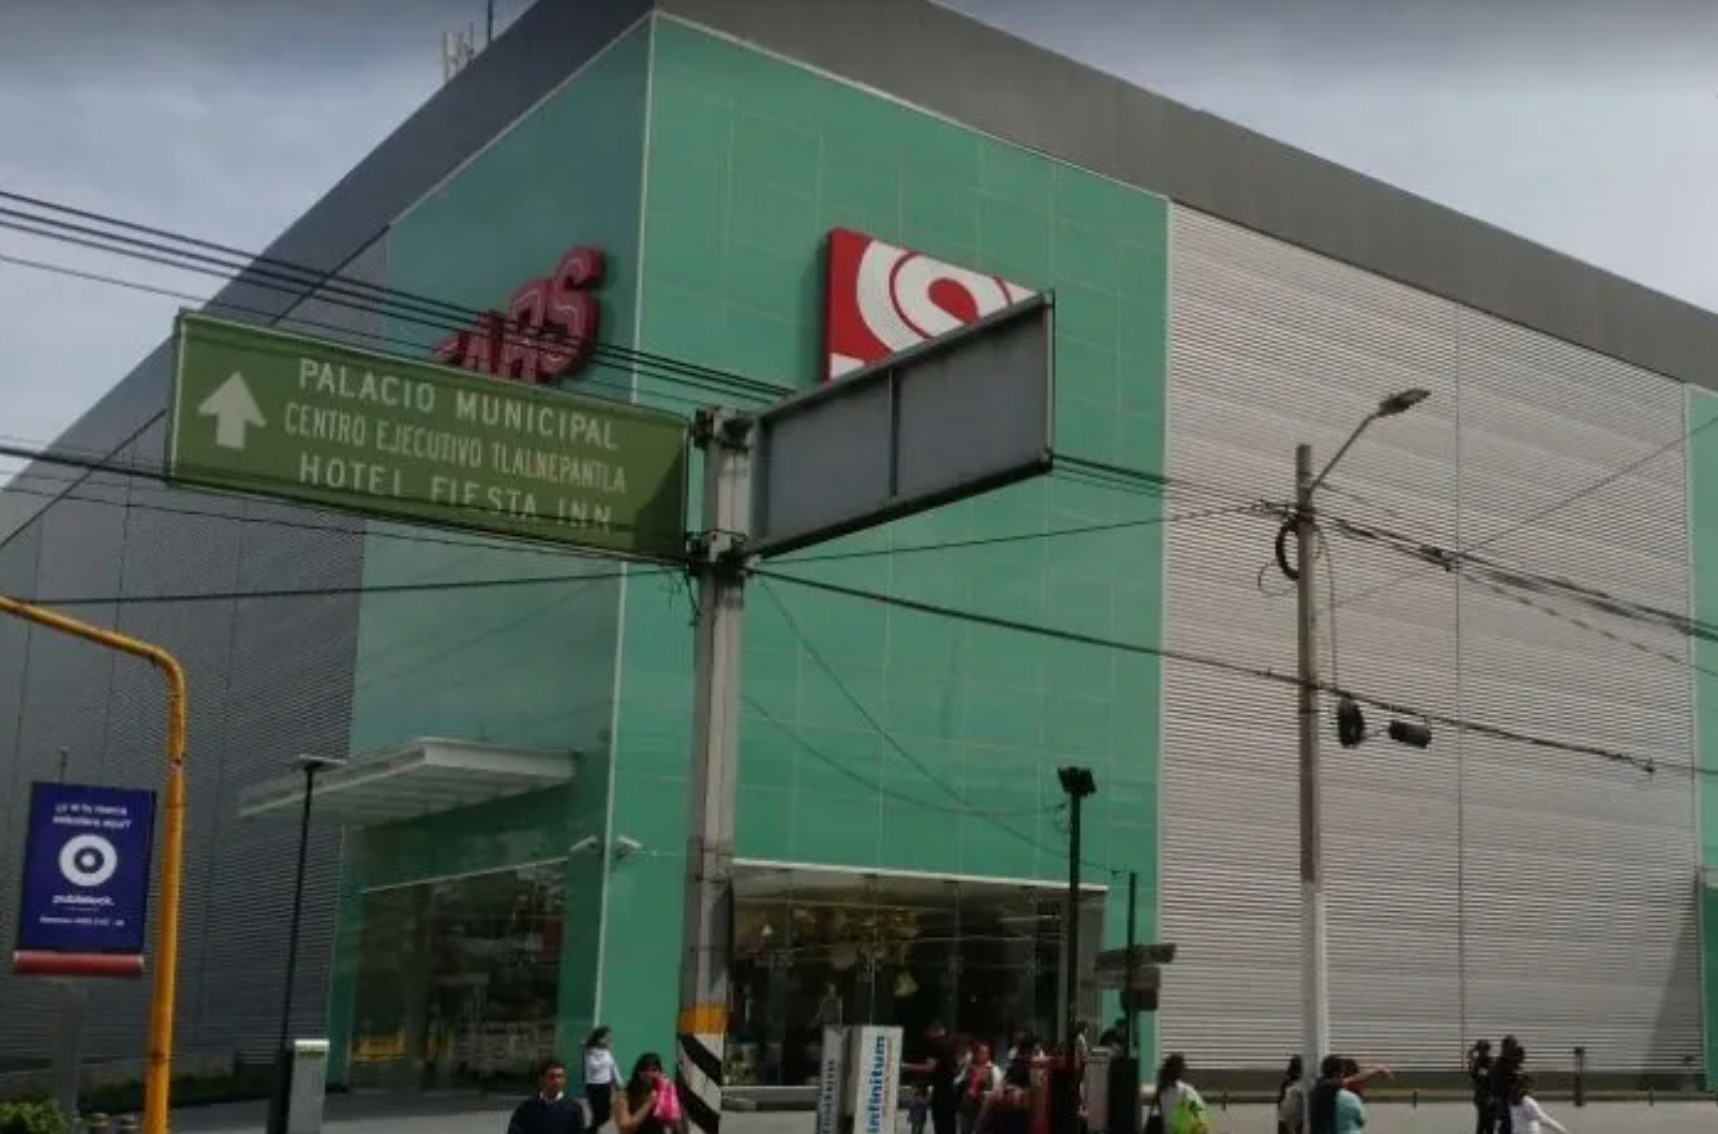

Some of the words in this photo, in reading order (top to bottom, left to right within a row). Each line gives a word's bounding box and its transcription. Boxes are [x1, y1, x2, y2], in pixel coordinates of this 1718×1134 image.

[284, 401, 366, 447] CENTRO
[375, 419, 482, 468] EJECUTIVO
[492, 441, 627, 495] TLALNEPANTLA
[299, 357, 435, 414] PALACIO
[455, 389, 619, 450] MUNICIPAL
[430, 475, 538, 520] FIESTA
[557, 497, 612, 529] INN
[866, 1035, 886, 1133] infinitum
